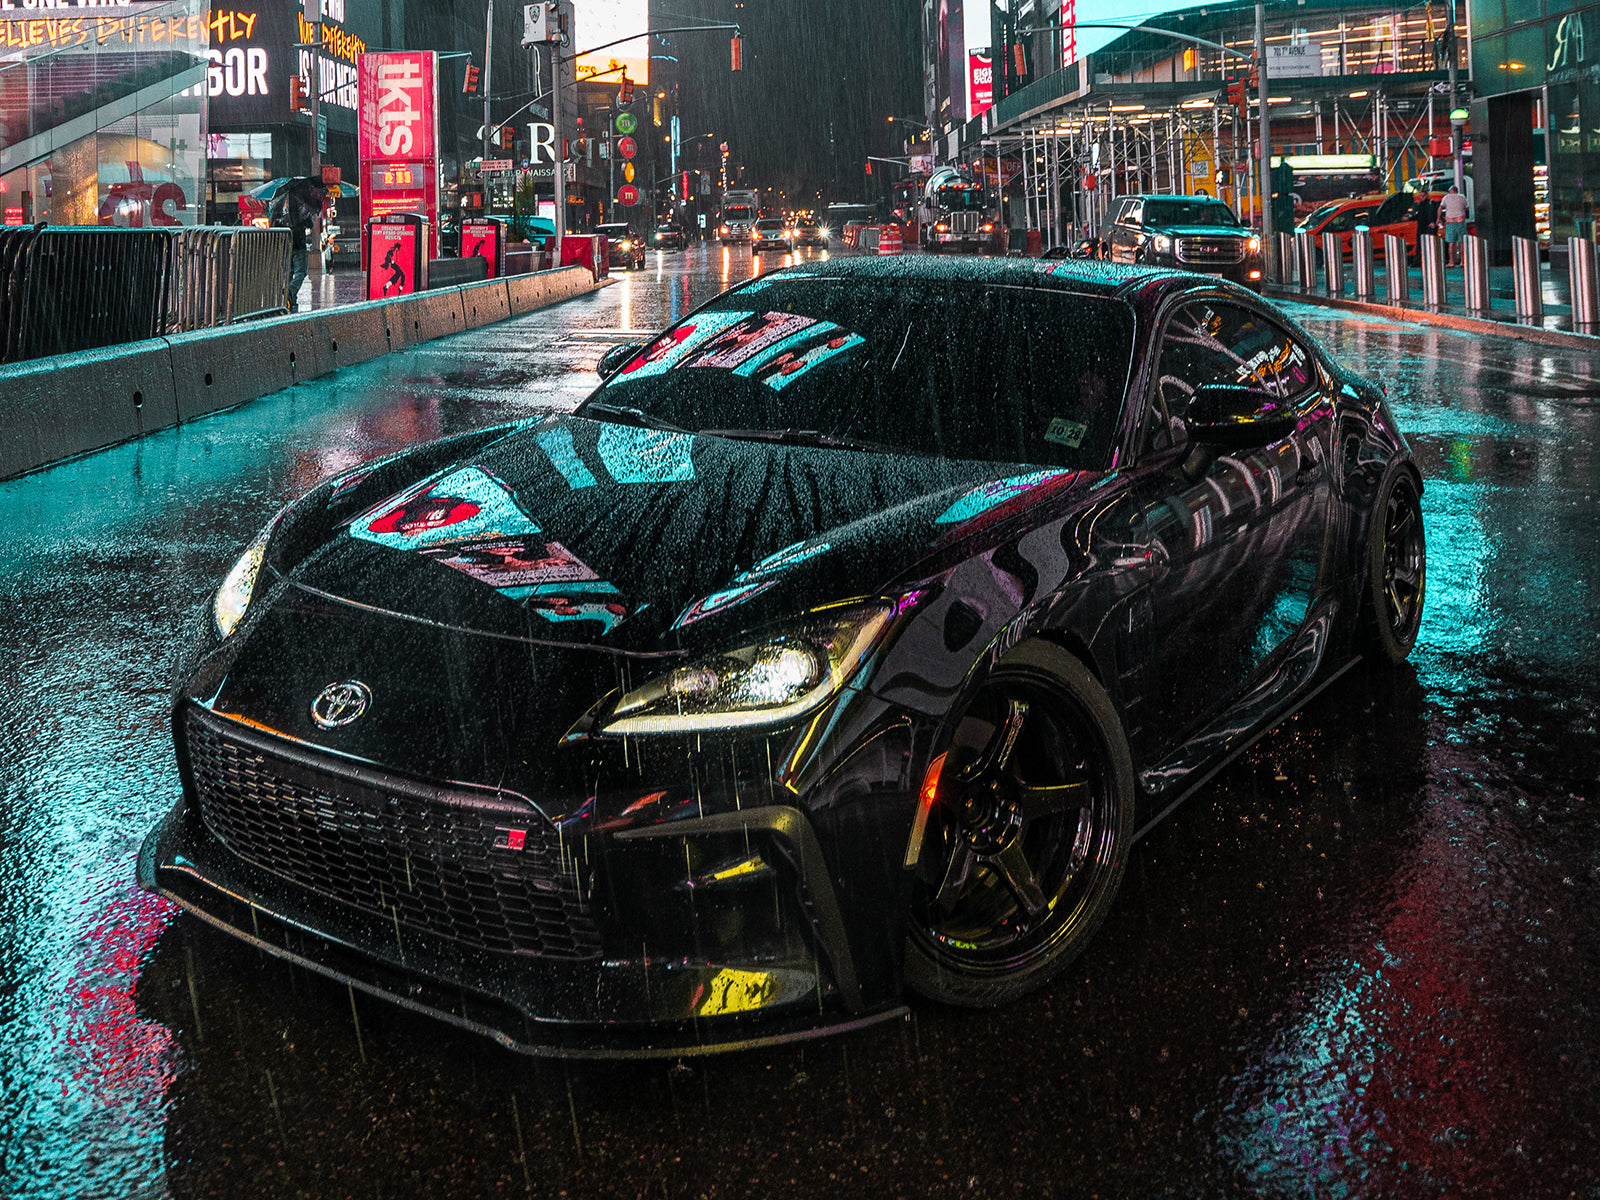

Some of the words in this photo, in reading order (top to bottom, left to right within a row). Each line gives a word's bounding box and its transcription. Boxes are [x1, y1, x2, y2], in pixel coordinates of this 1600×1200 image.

[378, 59, 423, 156] tkts
[526, 122, 571, 165] R
[624, 192, 634, 200] m
[1066, 428, 1081, 441] 28
